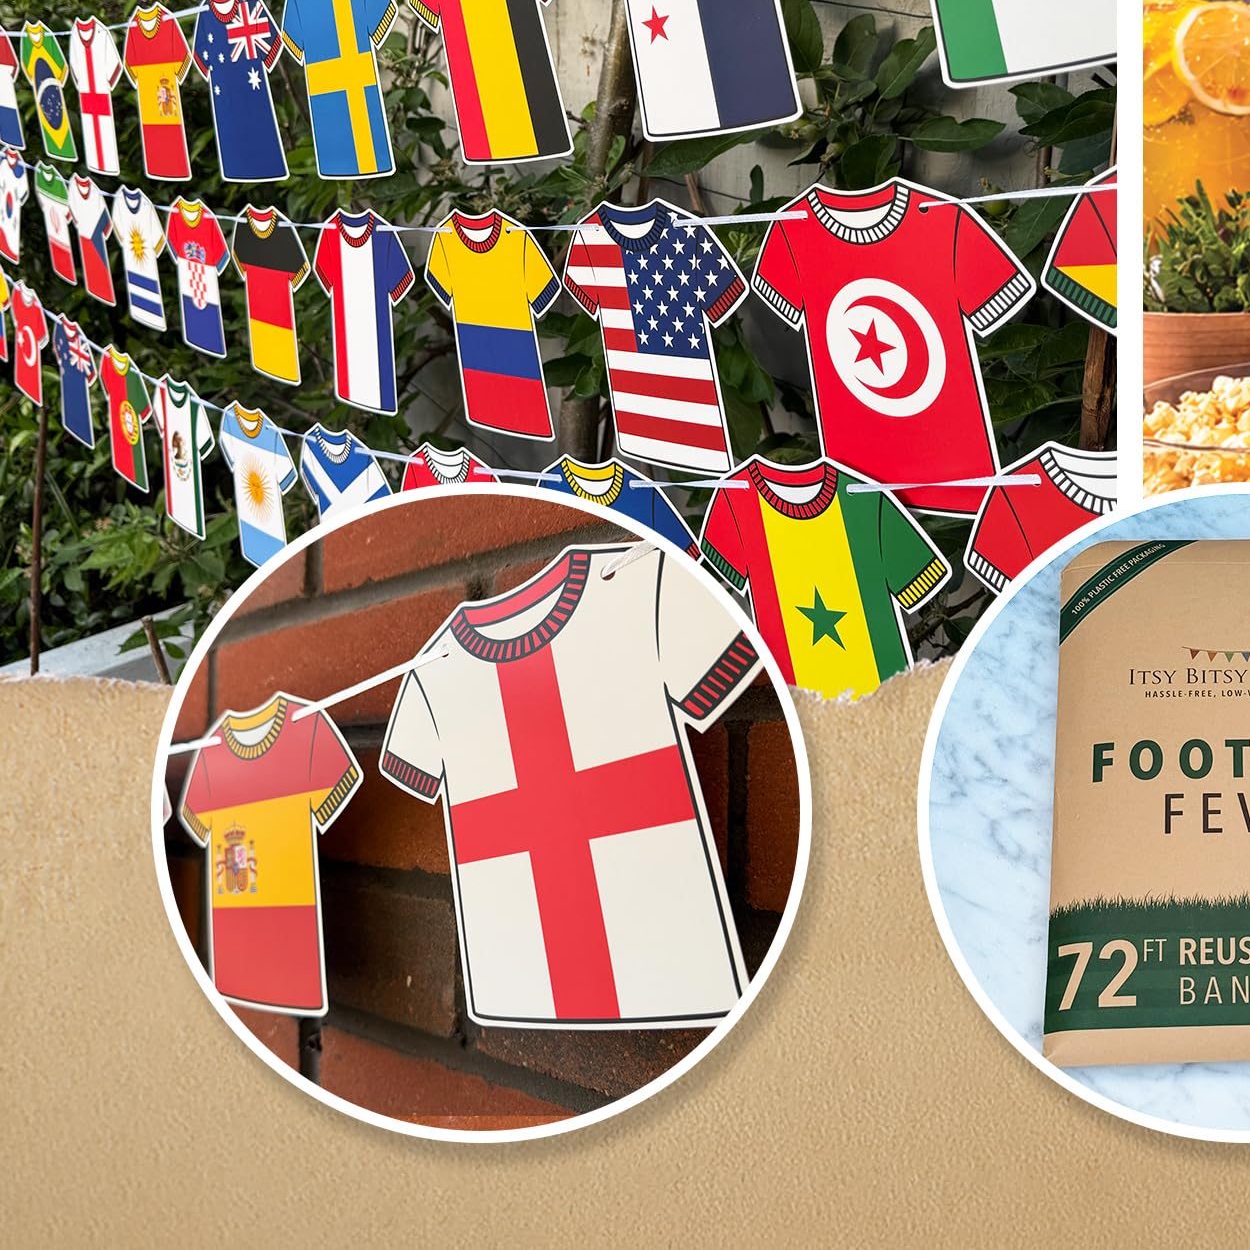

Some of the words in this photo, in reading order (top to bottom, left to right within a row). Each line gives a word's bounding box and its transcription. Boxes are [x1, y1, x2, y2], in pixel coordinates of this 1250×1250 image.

[1071, 596, 1090, 615] 100%
[1088, 575, 1115, 598] PLASTIC
[1112, 563, 1131, 578] FREE
[1128, 543, 1166, 566] PACKAGING
[1145, 689, 1217, 698] HASSLE-FREE,
[1057, 939, 1139, 1011] 72
[1143, 938, 1168, 962] FT
